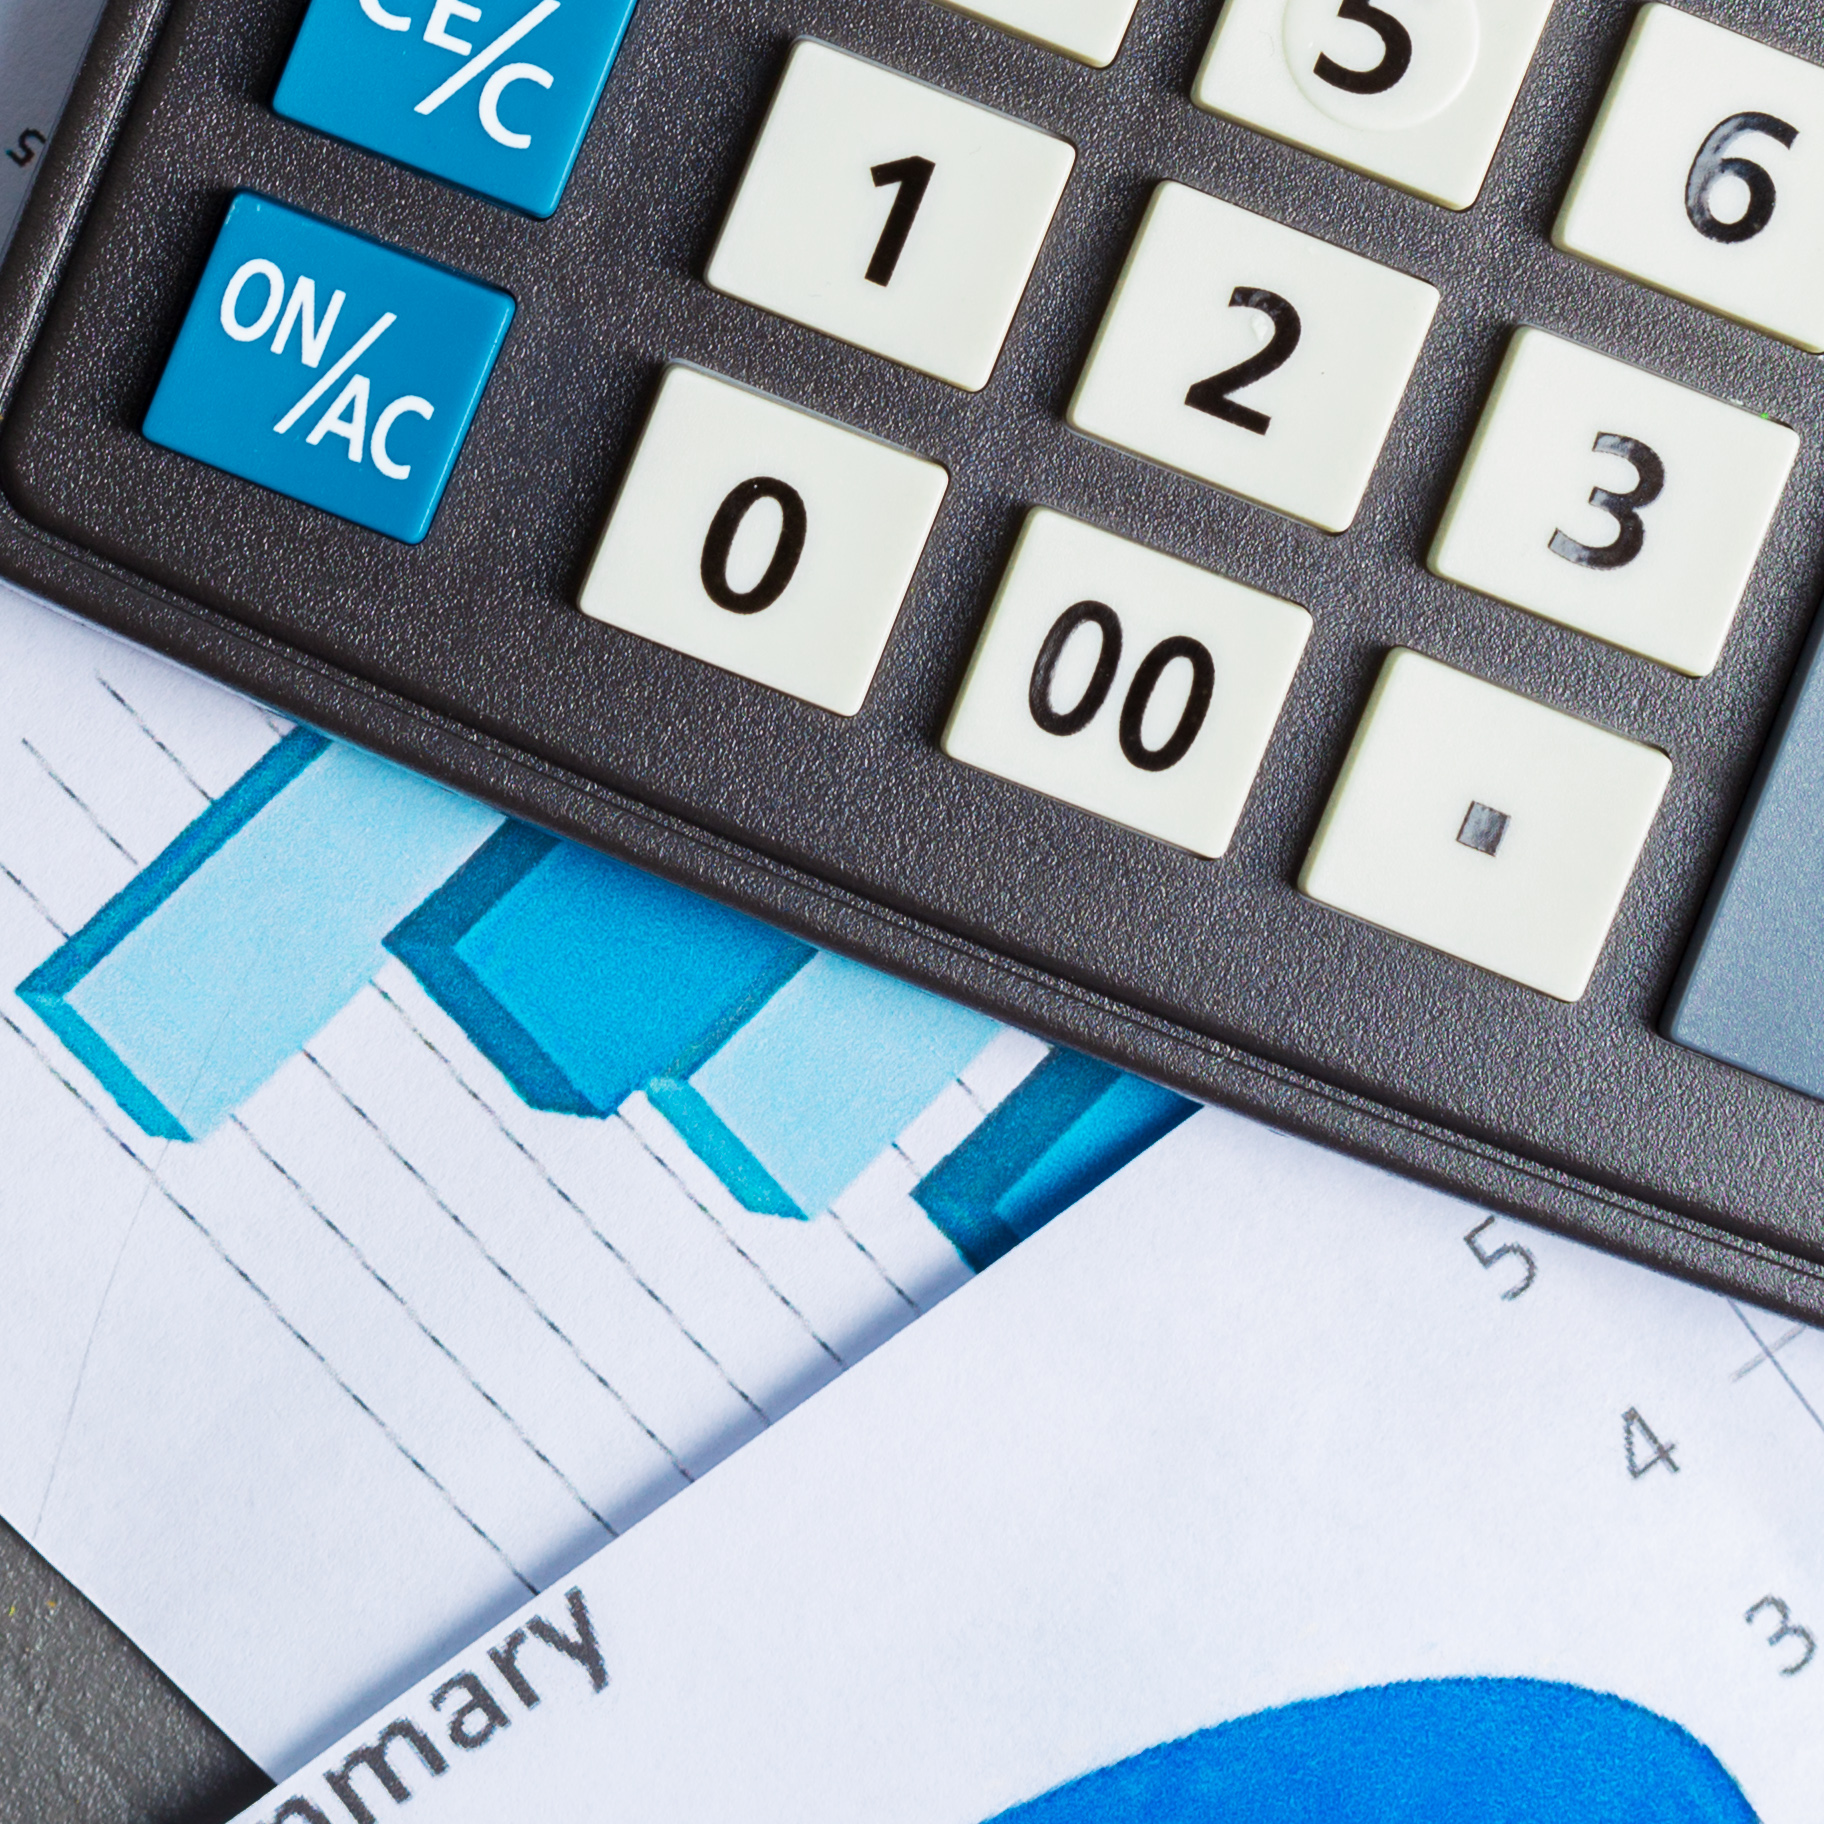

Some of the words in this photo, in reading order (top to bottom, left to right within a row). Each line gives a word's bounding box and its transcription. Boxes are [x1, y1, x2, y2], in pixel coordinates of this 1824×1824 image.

[865, 156, 935, 286] 1
[1685, 112, 1798, 244] 6
[221, 259, 434, 479] ON/AC
[1185, 287, 1301, 435] 2
[701, 477, 806, 614] 0
[1546, 432, 1665, 569] 3
[1029, 601, 1215, 772] 00
[1463, 1214, 1538, 1301] 5
[1622, 1407, 1680, 1479] 4
[1745, 1596, 1816, 1676] 3
